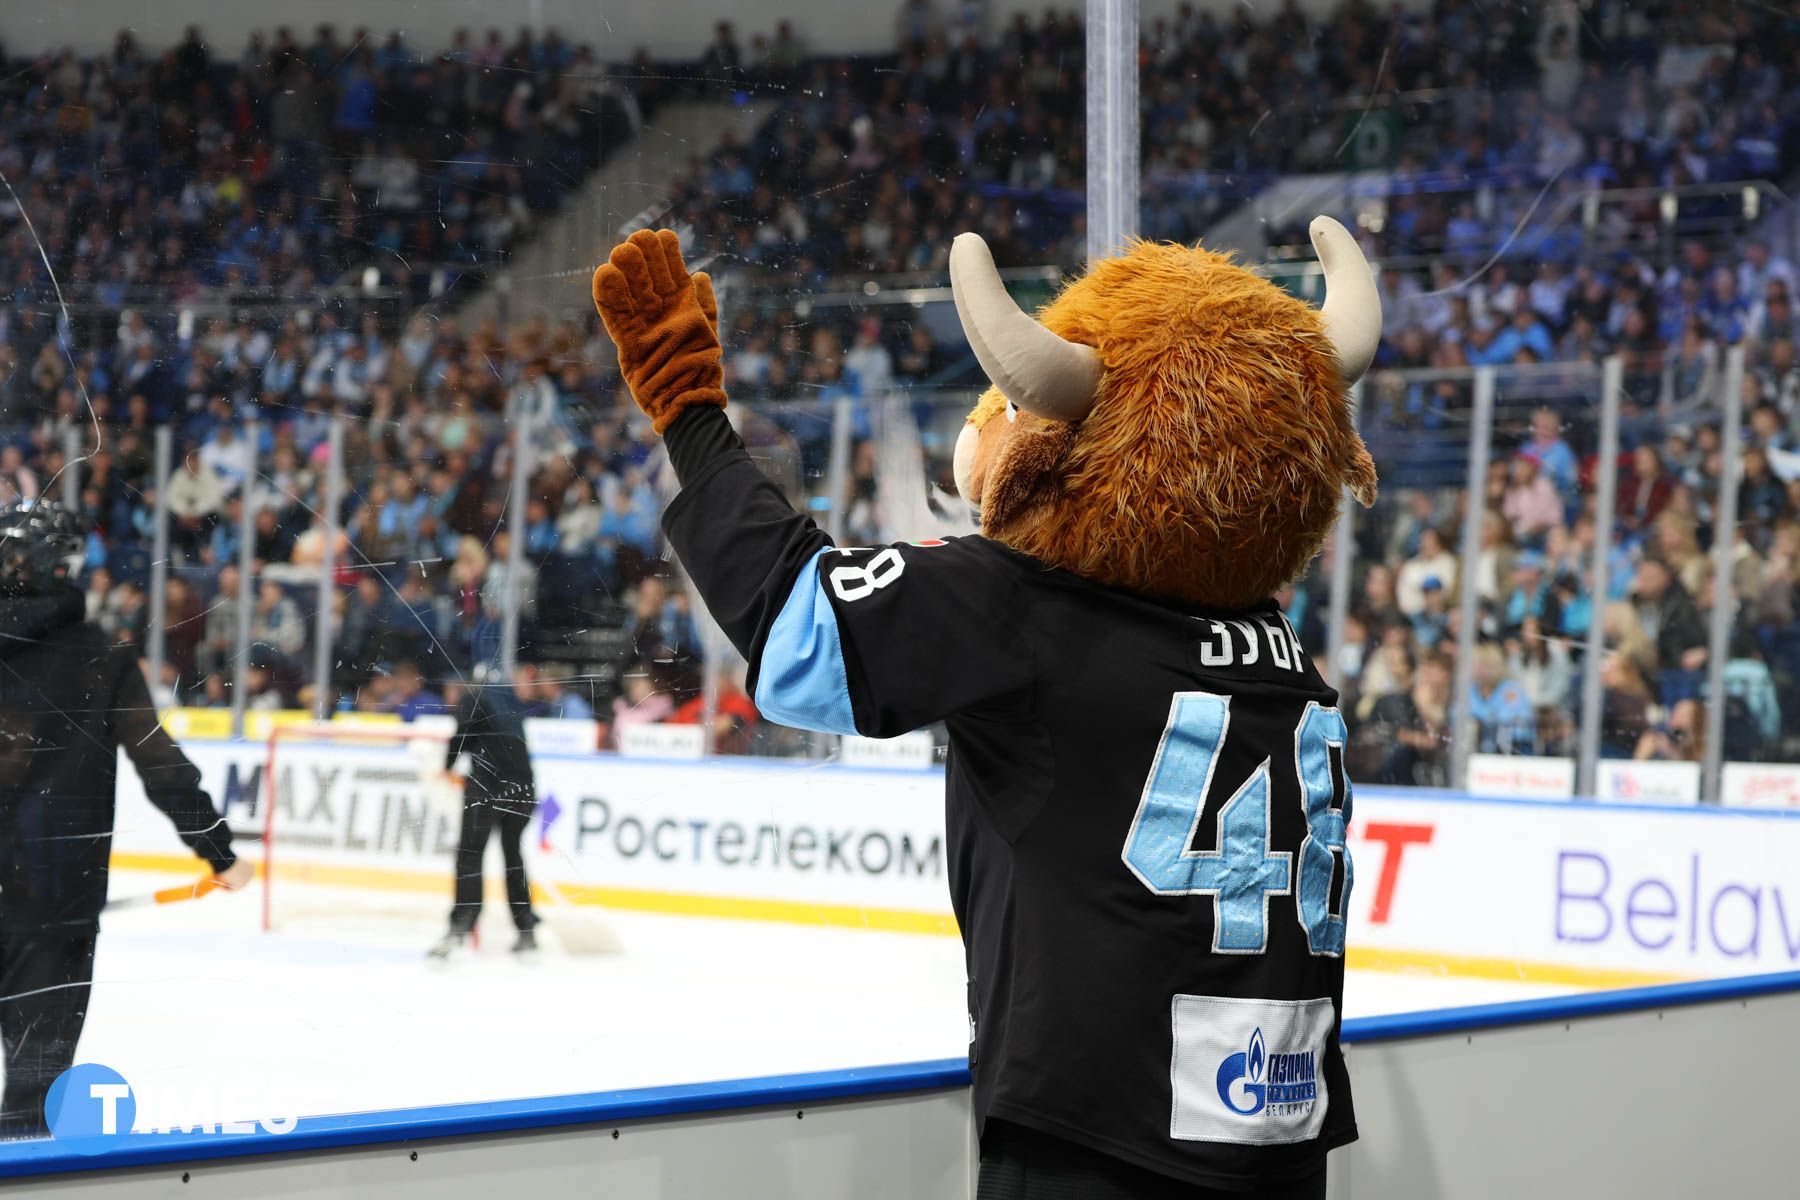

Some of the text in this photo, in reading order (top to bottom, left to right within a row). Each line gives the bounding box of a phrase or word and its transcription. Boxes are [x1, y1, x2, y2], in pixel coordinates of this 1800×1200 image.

[829, 547, 906, 602] 8
[573, 795, 944, 878] Ростелеком
[1121, 691, 1353, 958] 48
[1267, 1050, 1315, 1084] ГАЗПРОМ
